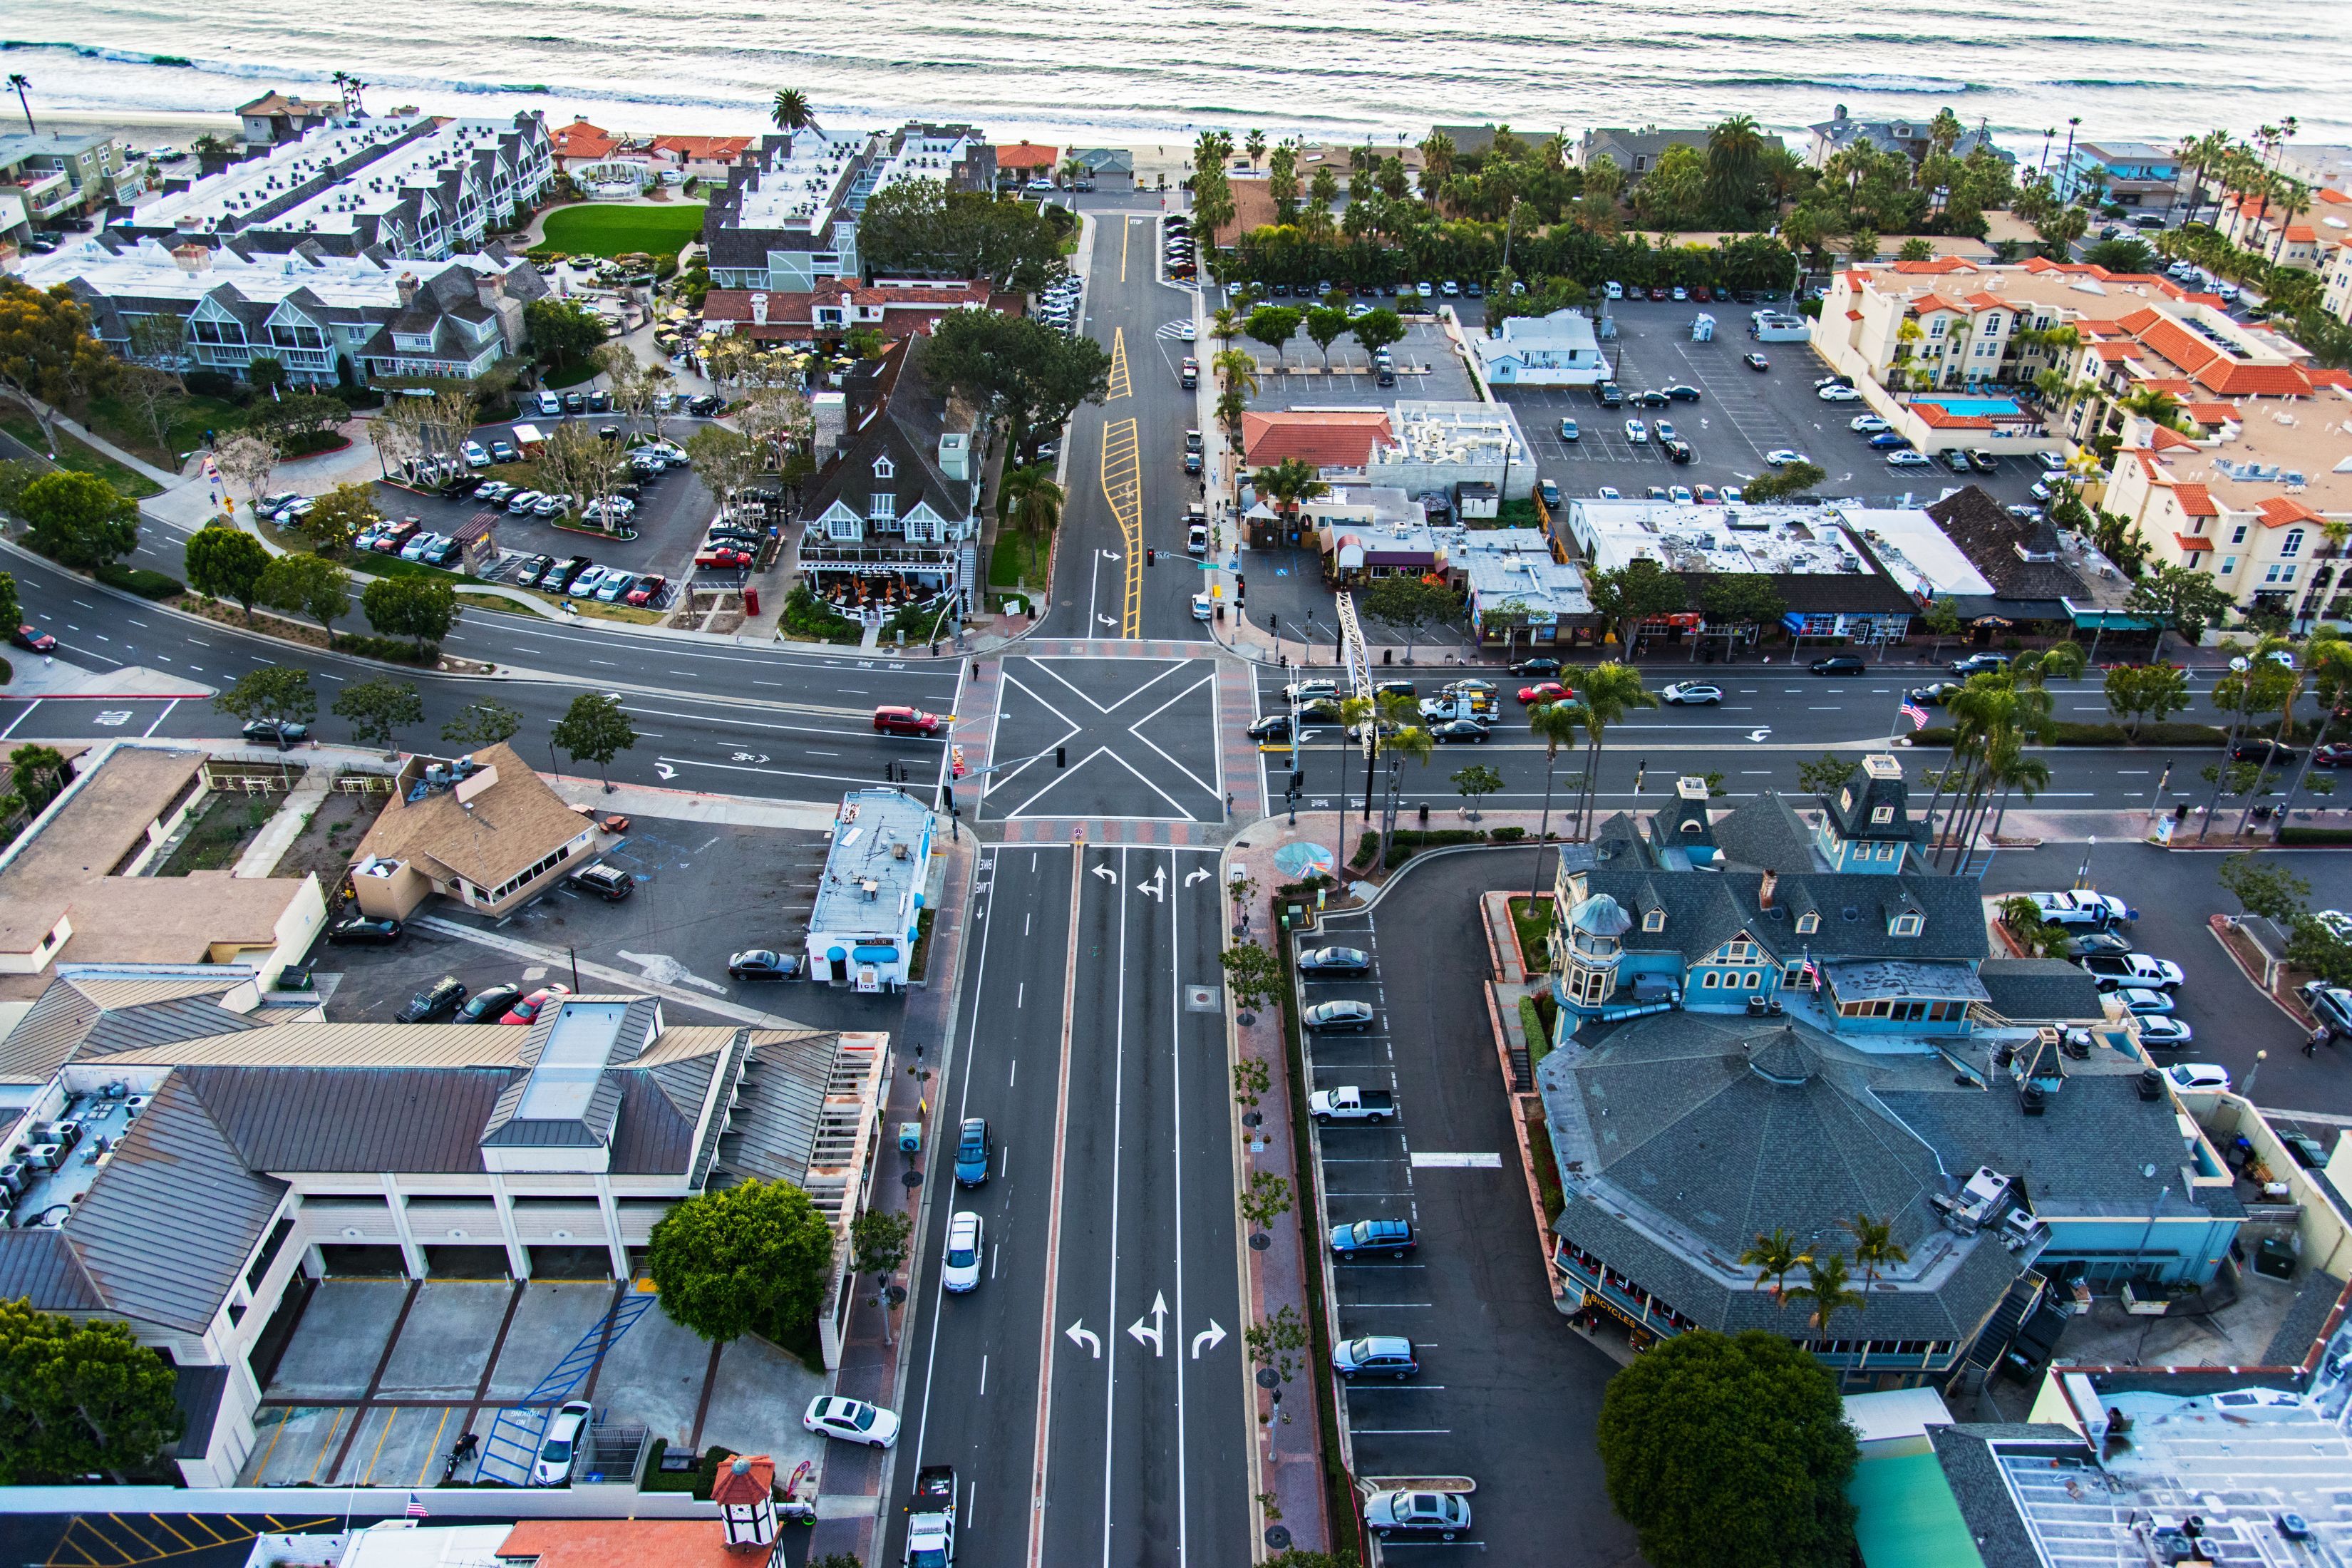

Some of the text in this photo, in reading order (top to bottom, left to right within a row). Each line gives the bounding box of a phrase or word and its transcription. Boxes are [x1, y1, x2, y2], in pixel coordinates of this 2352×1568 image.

[979, 859, 993, 870] BIKE
[976, 882, 991, 894] LANE
[1591, 1294, 1636, 1328] BICYCLES
